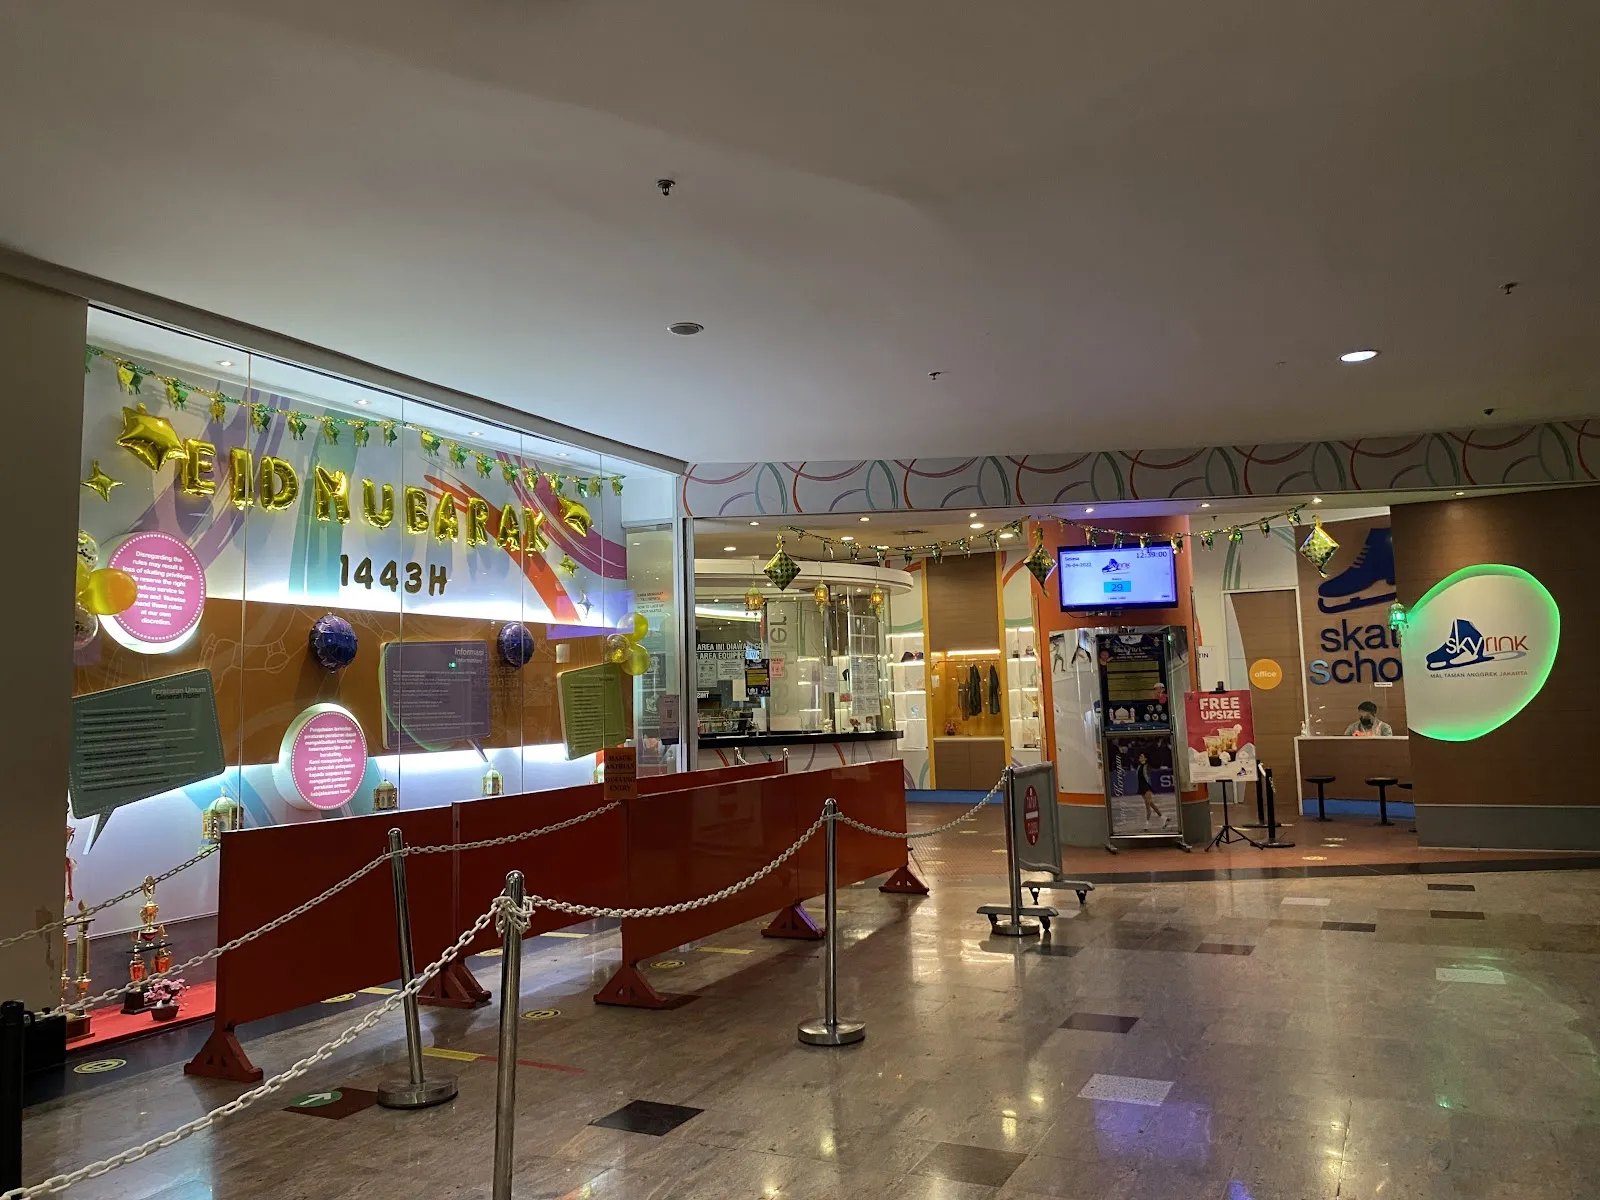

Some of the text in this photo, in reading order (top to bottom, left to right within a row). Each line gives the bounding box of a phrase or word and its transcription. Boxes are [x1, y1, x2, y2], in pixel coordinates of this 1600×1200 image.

[182, 438, 549, 554] EID MUBARAK
[136, 551, 172, 562] Disregarding
[144, 568, 165, 577] skating
[166, 571, 194, 580] privileges.
[340, 554, 448, 596] 1443H
[1112, 583, 1123, 592] 29
[454, 648, 484, 656] Informasi
[1309, 651, 1403, 685] scho
[1199, 697, 1240, 710] FREE
[1200, 710, 1241, 720] UPSIZE
